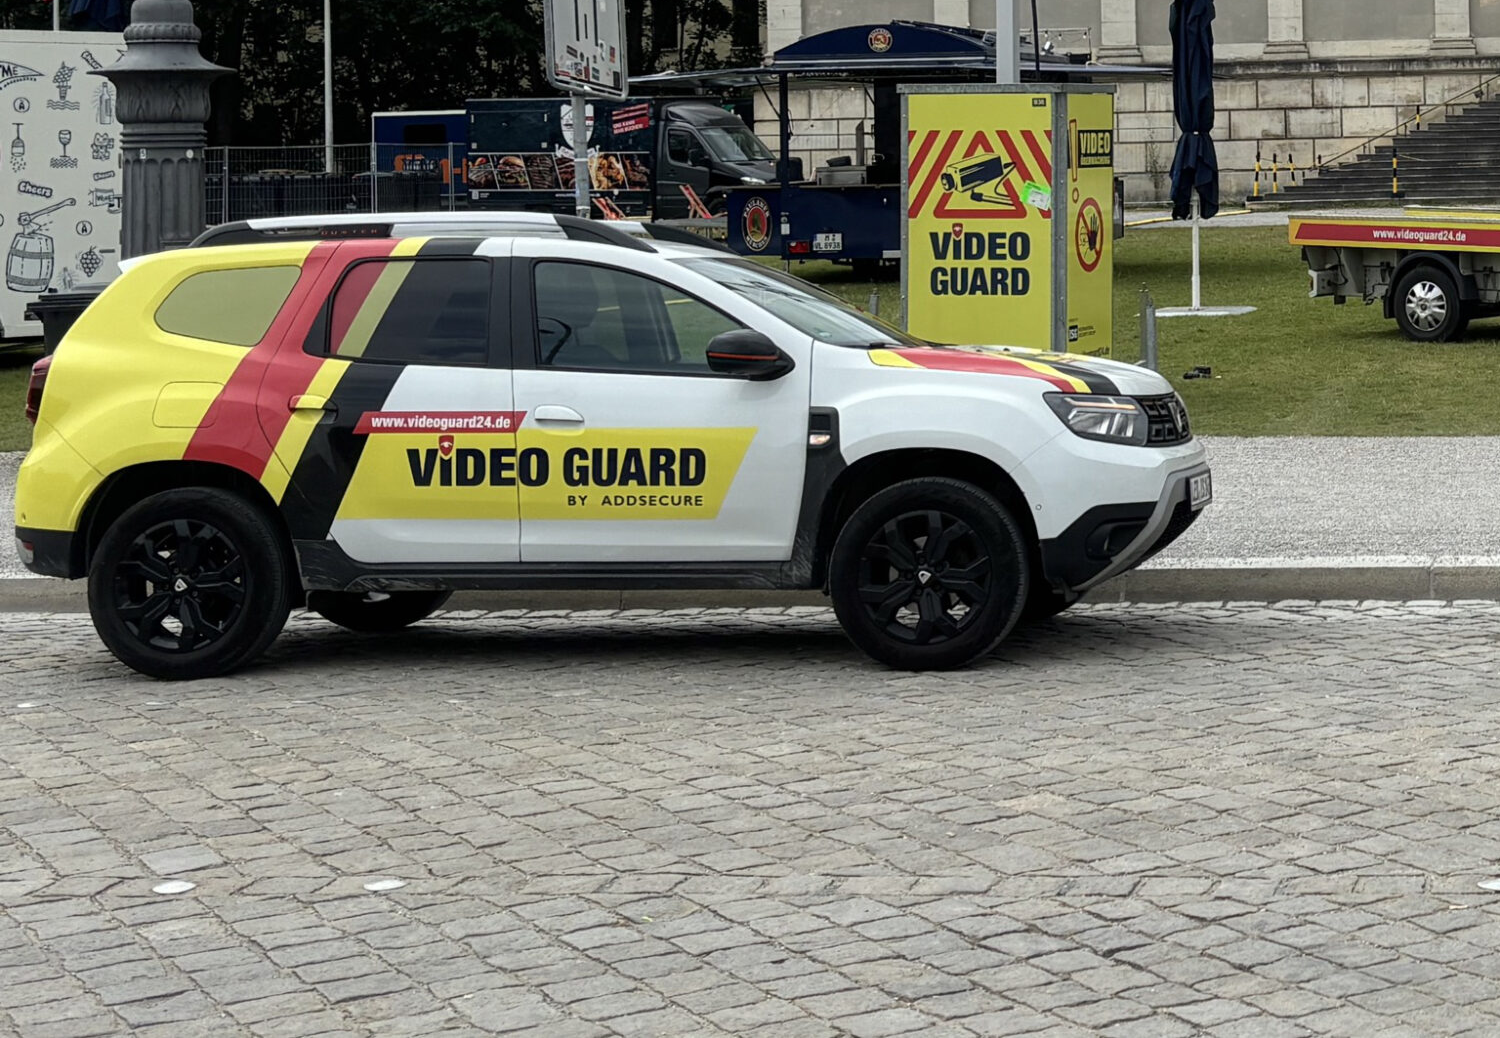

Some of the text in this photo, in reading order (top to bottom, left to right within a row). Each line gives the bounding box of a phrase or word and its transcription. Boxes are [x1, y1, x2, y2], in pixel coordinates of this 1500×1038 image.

[1080, 132, 1111, 154] VIDEO
[19, 181, 53, 198] Cheers
[1372, 229, 1467, 243] www.videoguard24.de
[930, 266, 1031, 296] GUARD
[371, 415, 511, 430] www.videoguard24.de
[563, 448, 707, 487] GUARD
[567, 495, 704, 506] BY ADDSECURE
